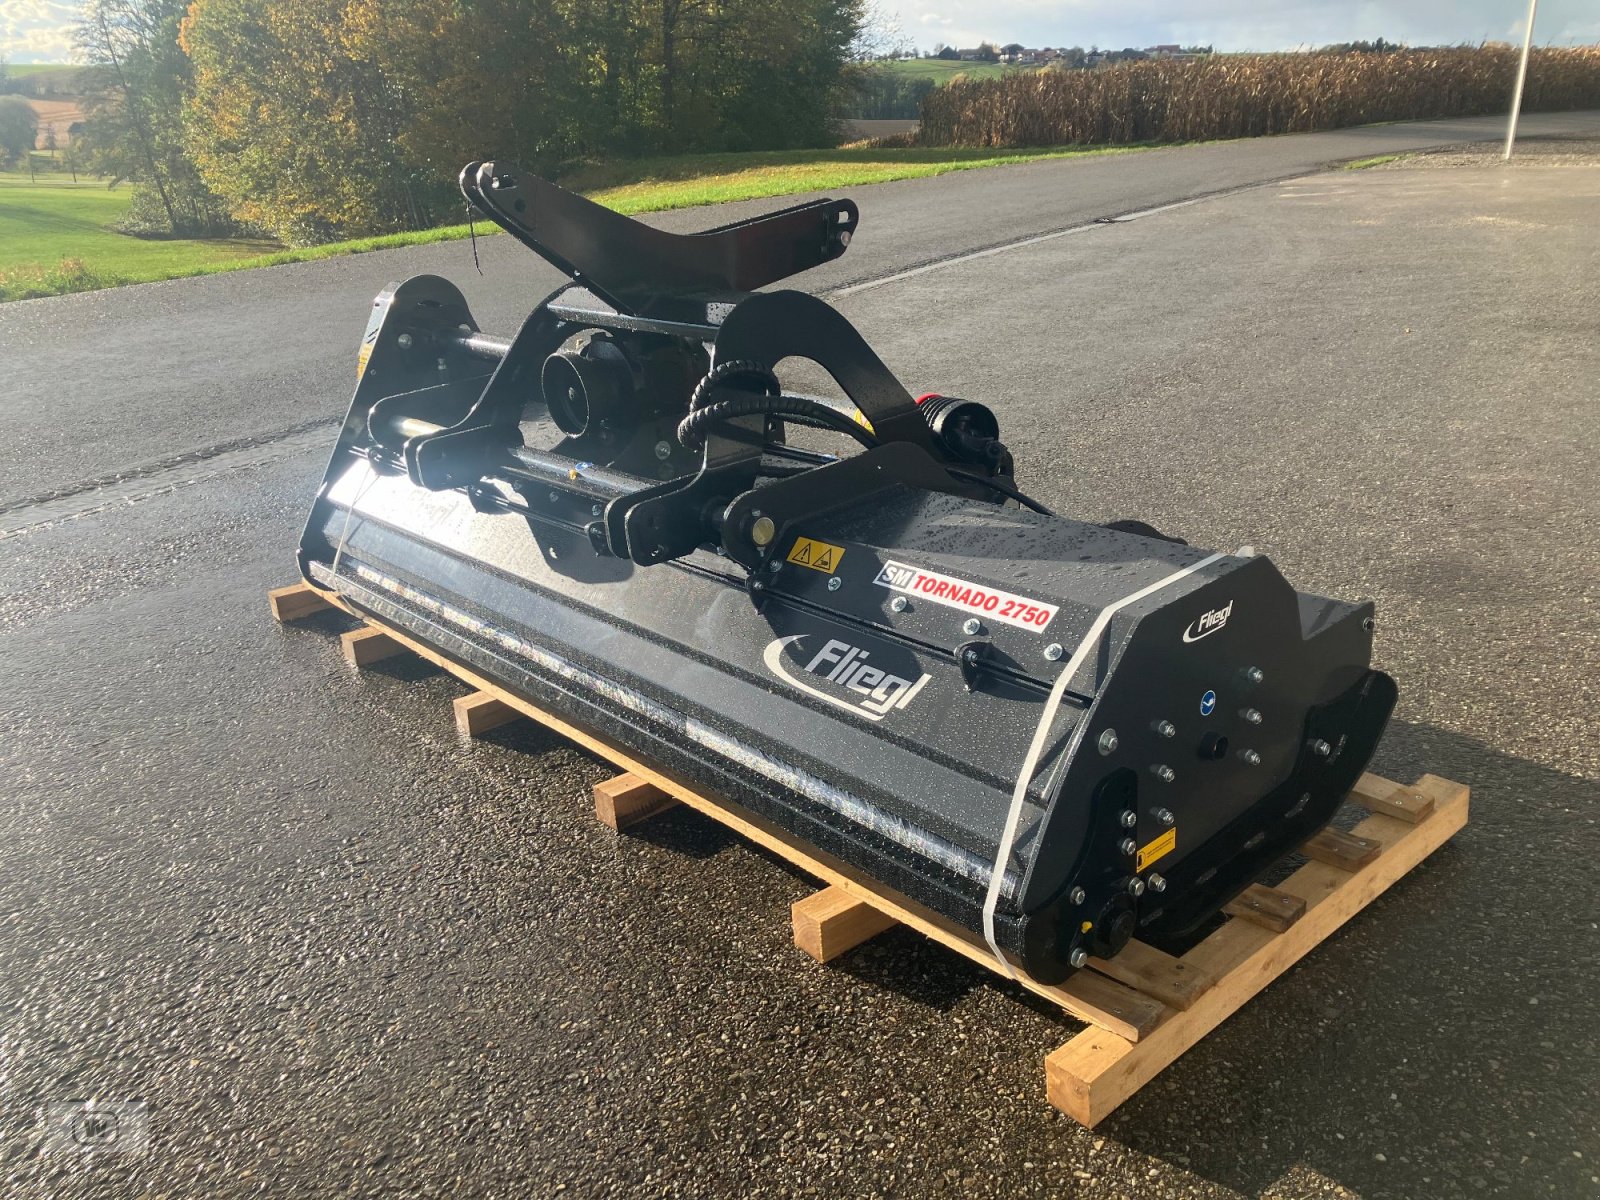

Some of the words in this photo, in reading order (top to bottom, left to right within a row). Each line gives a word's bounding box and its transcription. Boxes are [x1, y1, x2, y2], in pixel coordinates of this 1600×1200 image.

[882, 565, 912, 588] SM
[913, 575, 1000, 611] TORNADO
[998, 600, 1050, 626] 2750
[1198, 599, 1234, 632] Fliegl
[804, 638, 932, 714] Fliegl
